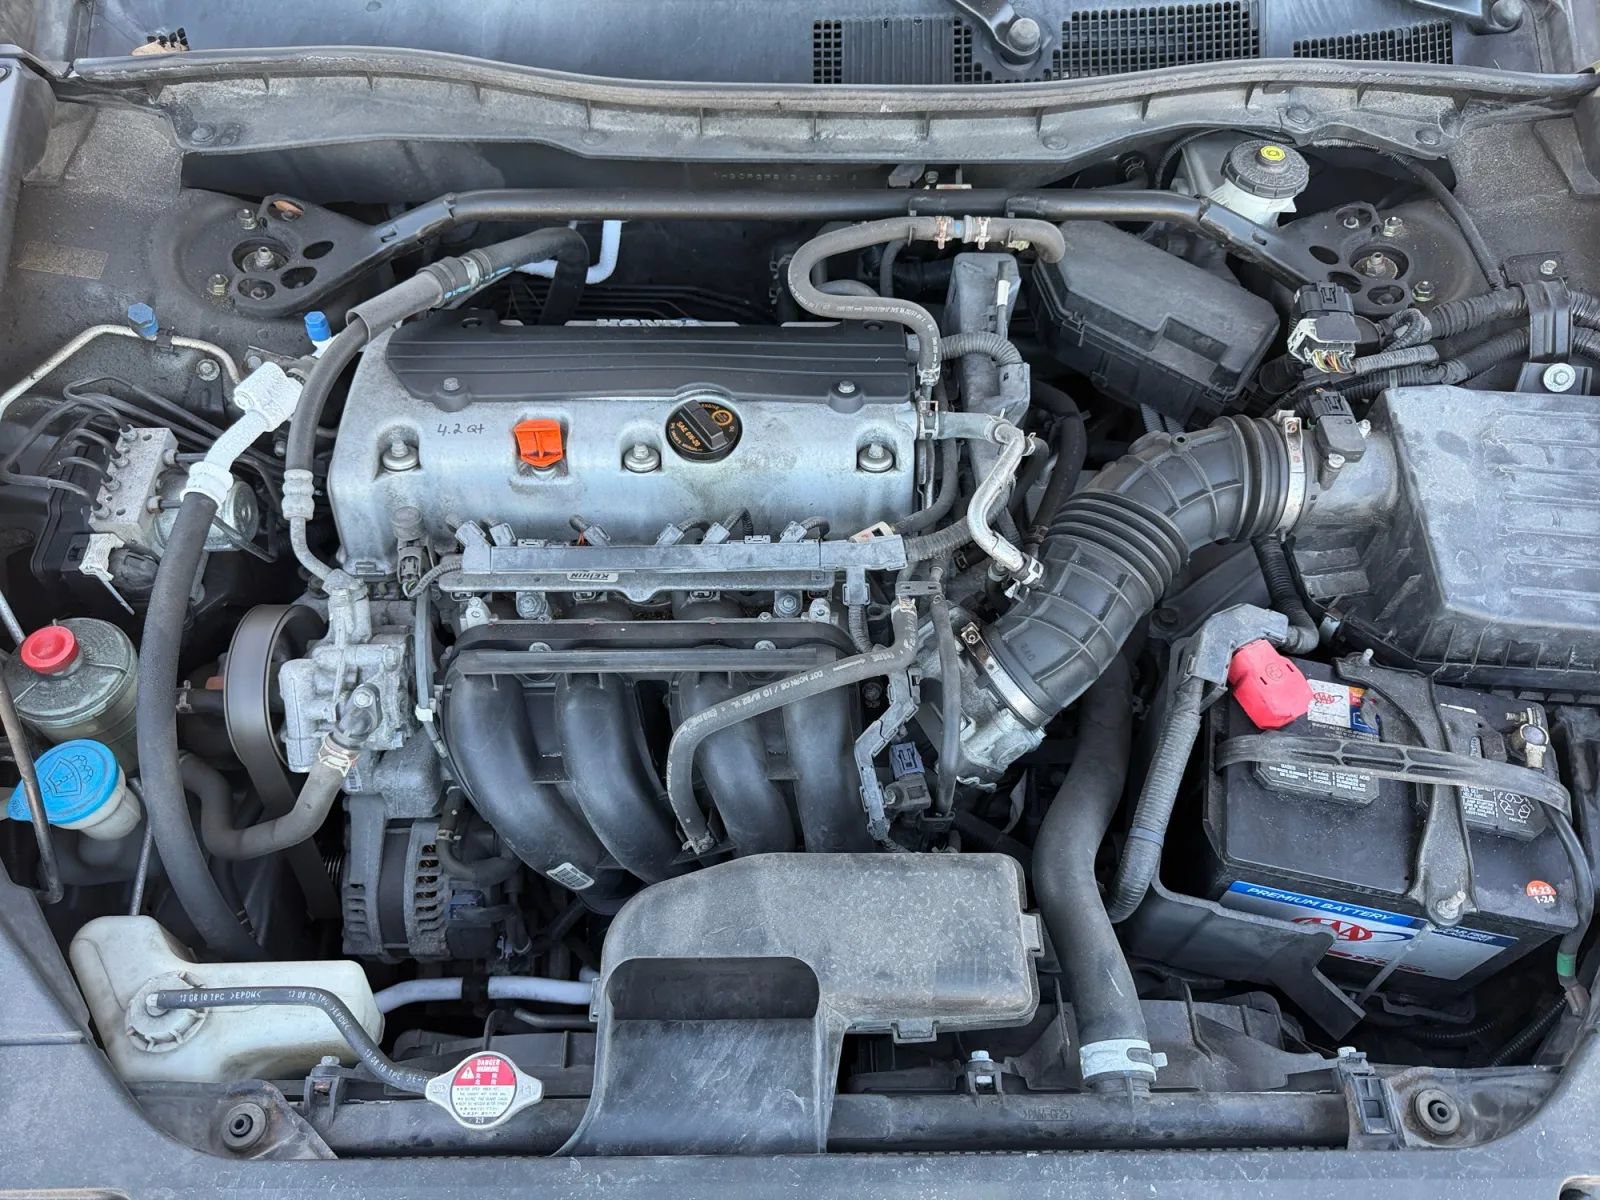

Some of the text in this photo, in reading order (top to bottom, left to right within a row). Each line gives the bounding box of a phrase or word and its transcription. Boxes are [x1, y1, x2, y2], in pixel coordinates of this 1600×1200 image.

[437, 423, 463, 437] 4.2
[570, 572, 610, 580] KEIHIN
[1247, 887, 1393, 921] PREMIUM BATTERY
[1534, 895, 1556, 904] 1-24
[476, 1058, 500, 1066] DANGER
